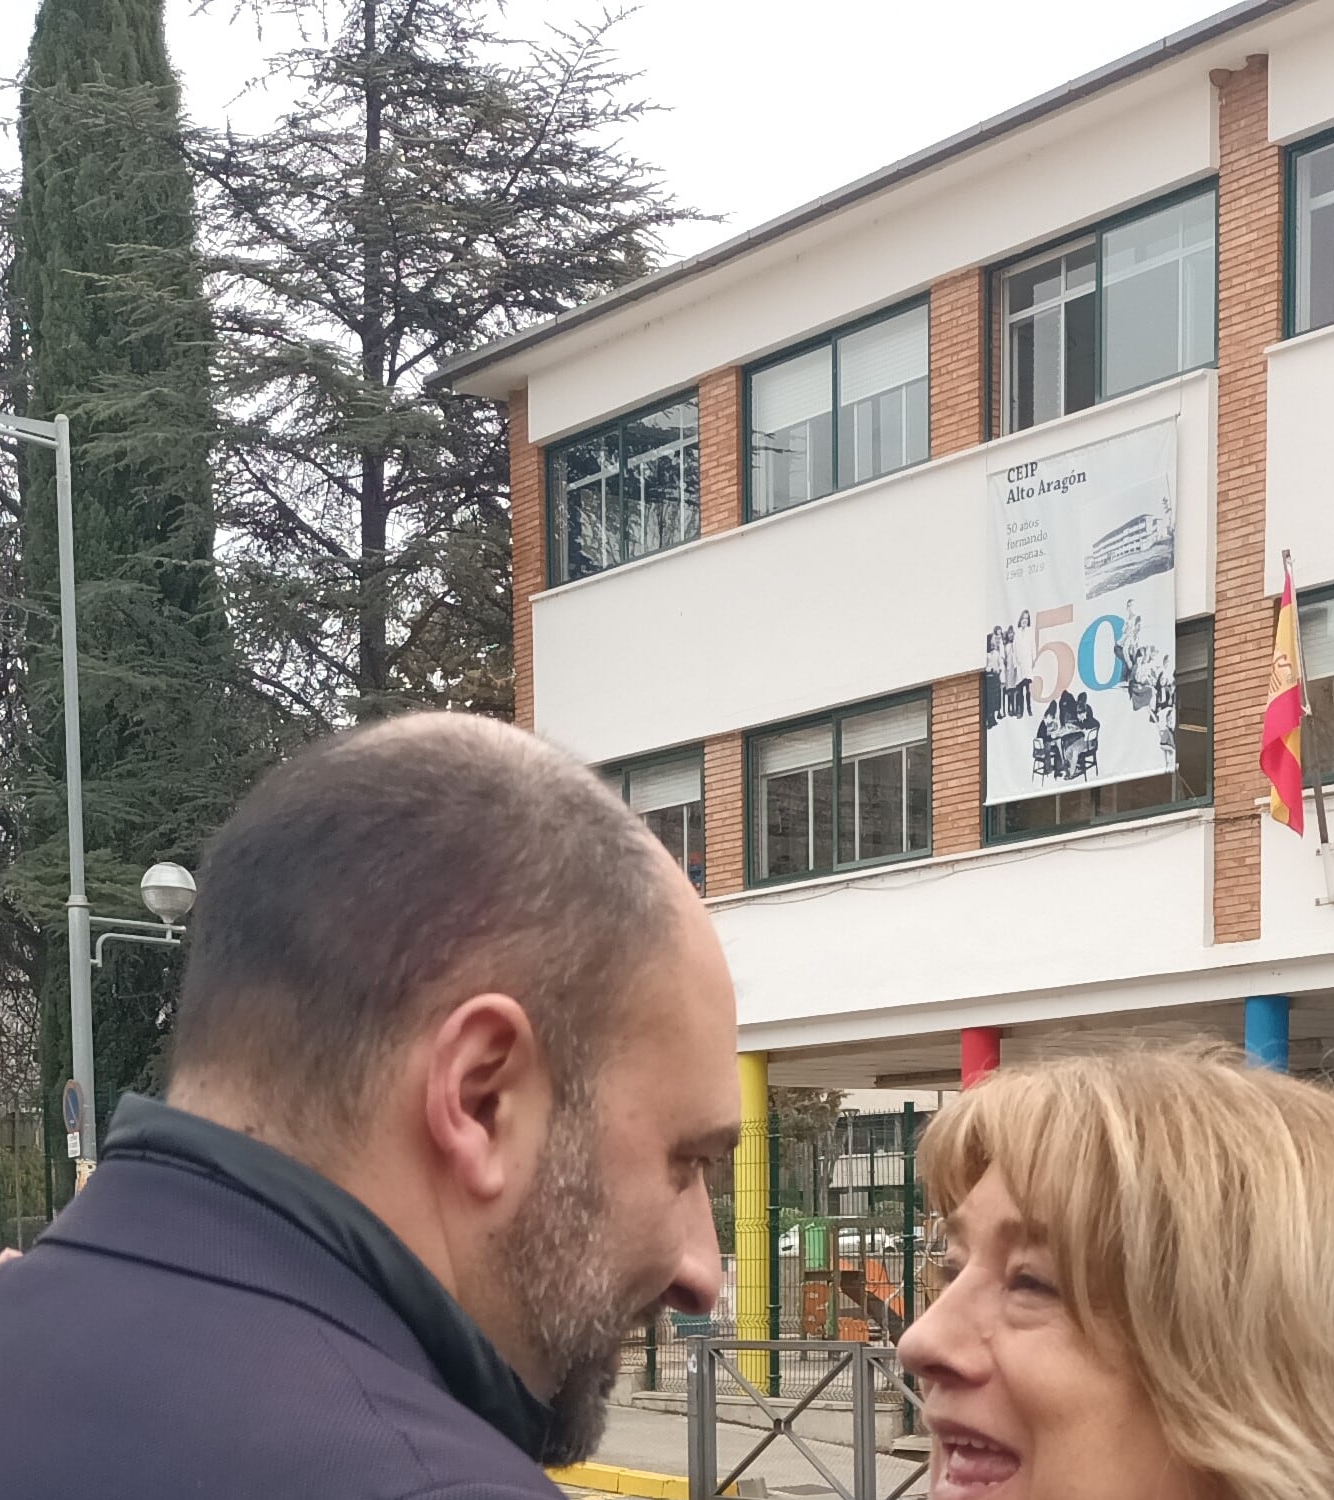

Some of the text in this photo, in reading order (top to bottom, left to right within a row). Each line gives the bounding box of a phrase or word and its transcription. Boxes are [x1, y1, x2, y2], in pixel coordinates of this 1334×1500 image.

[1007, 461, 1038, 484] CEIP
[1006, 470, 1087, 505] Alto Aragón
[1007, 529, 1048, 550] formando
[1032, 604, 1126, 703] 50
